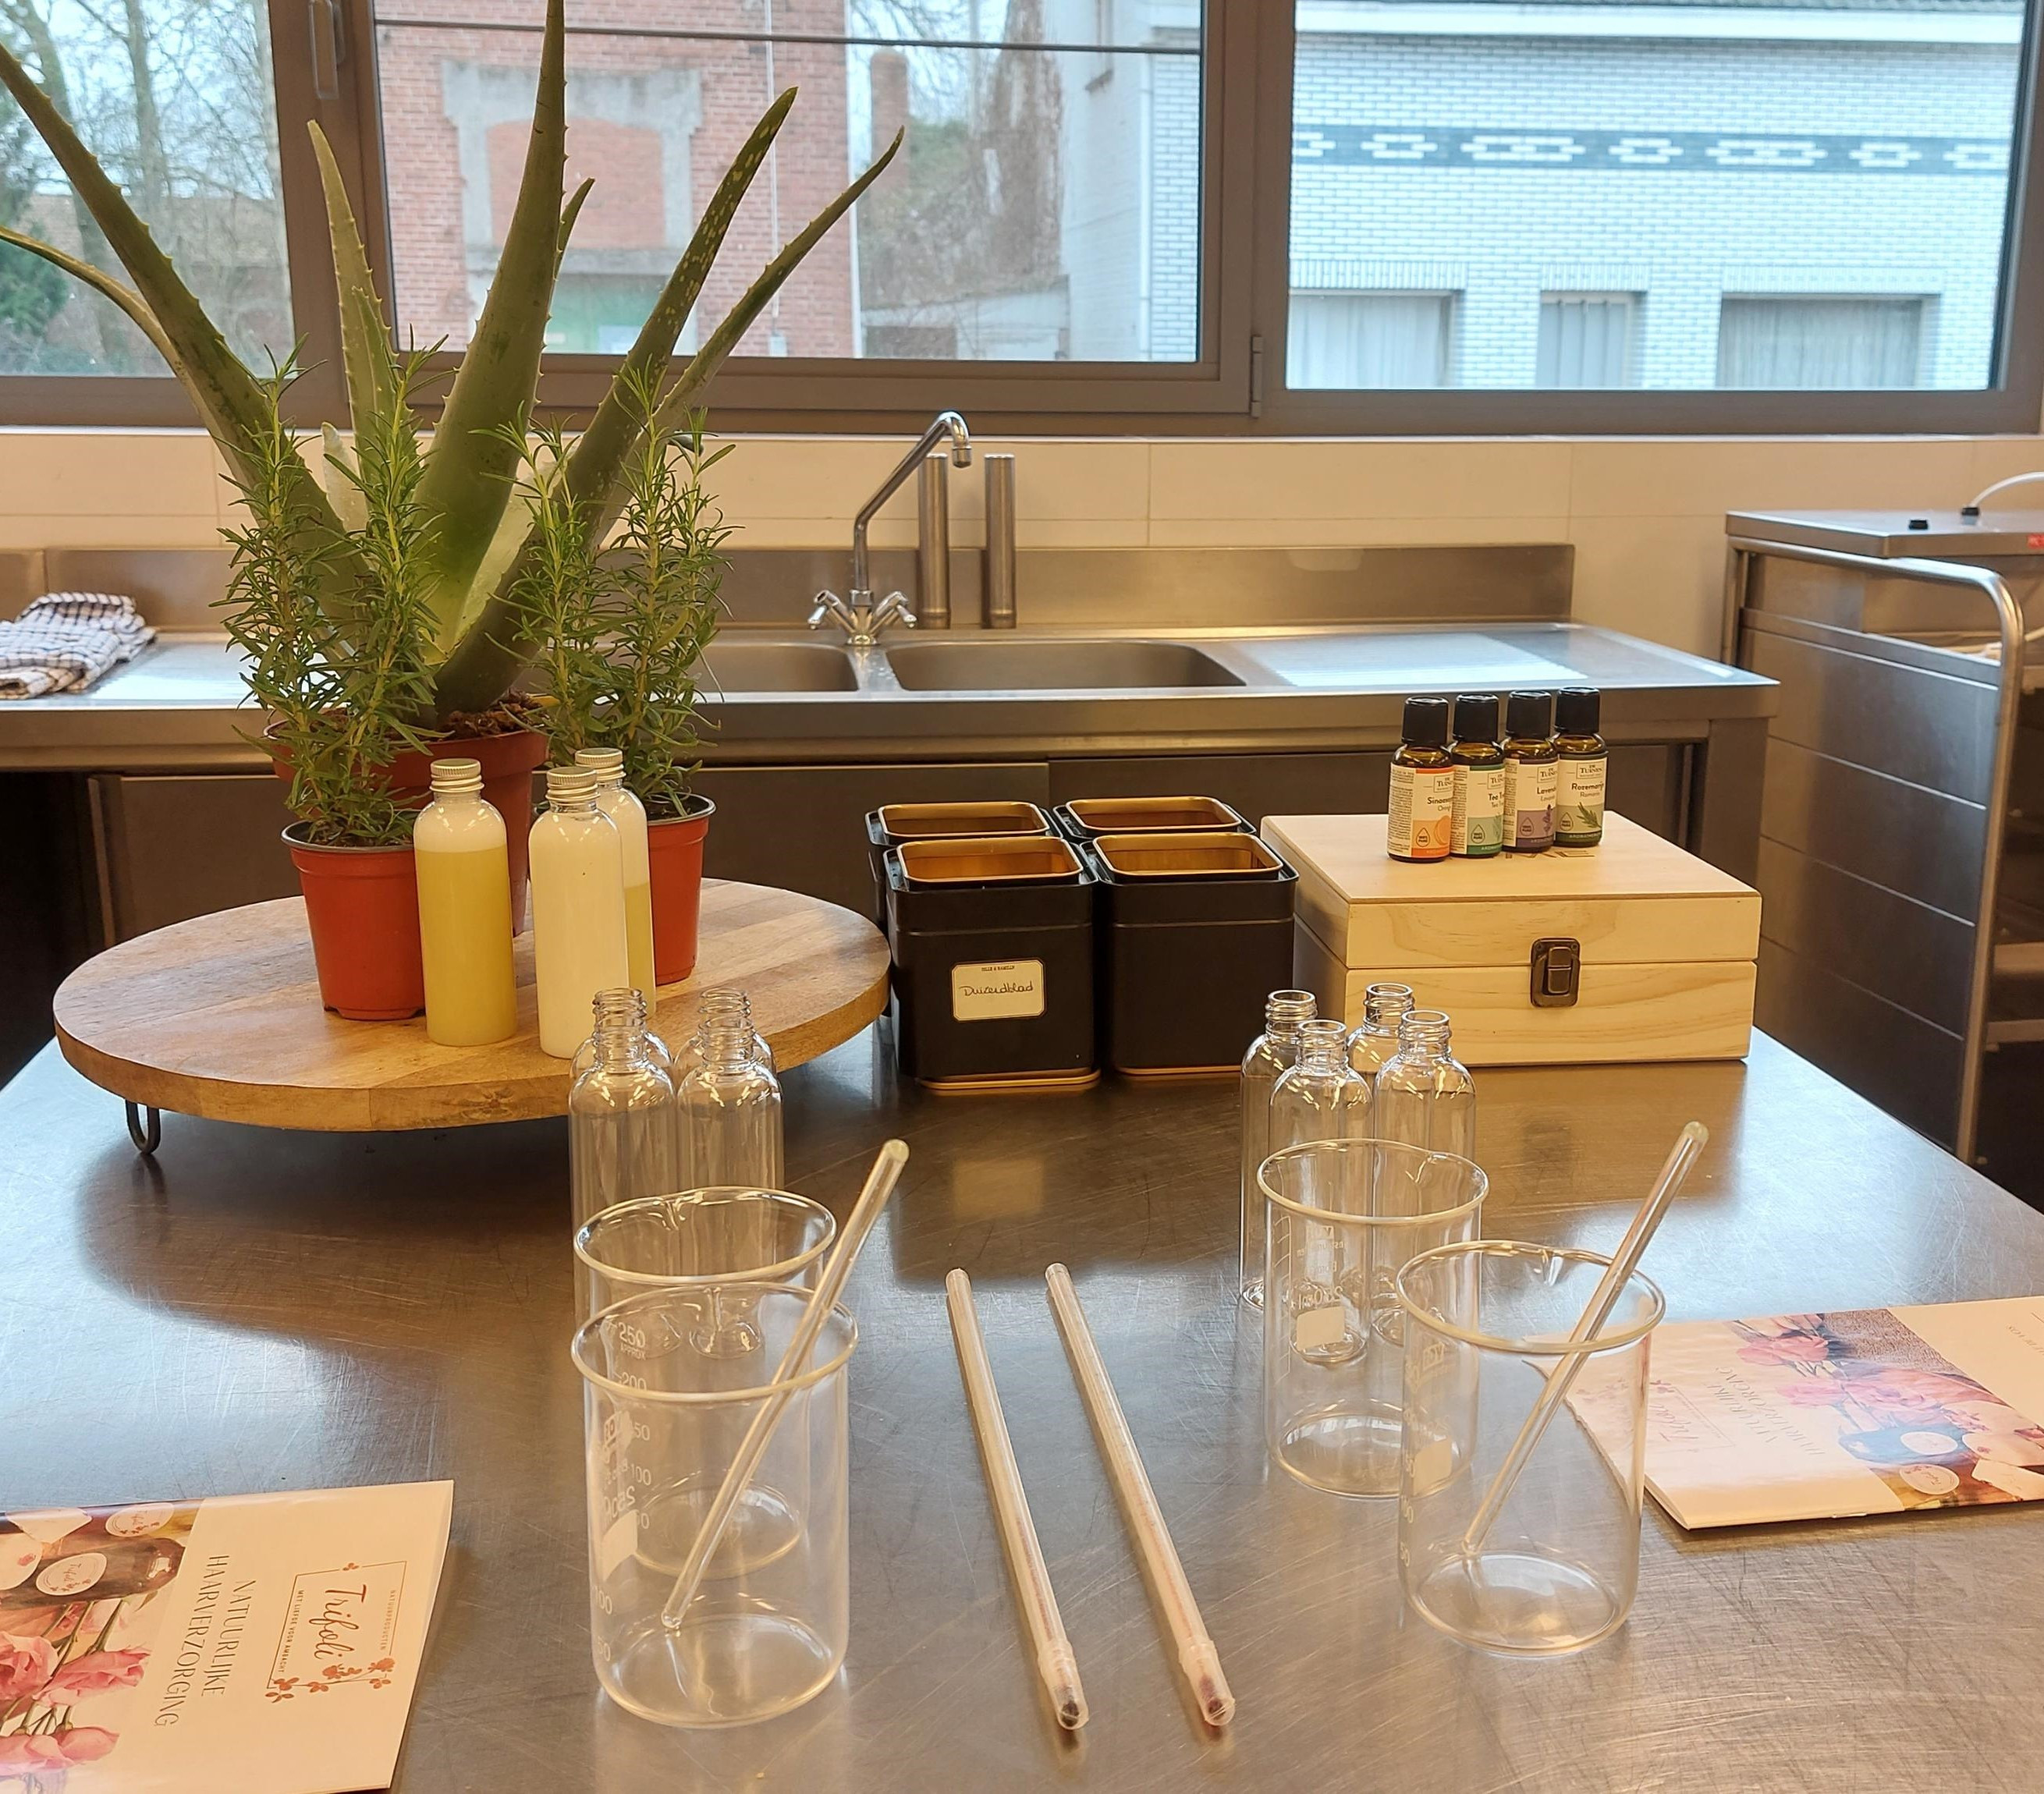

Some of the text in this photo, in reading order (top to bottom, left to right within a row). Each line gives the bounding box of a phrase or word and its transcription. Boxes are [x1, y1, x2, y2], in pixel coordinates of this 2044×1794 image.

[618, 1322, 646, 1349] 250
[633, 1425, 651, 1441] 50
[631, 1463, 651, 1486] 100
[292, 1604, 301, 1624] LIEFDE
[308, 1584, 367, 1660] Trifoli
[154, 1555, 230, 1727] HAARVERZORGING
[201, 1580, 257, 1697] NATUURLIJKE
[286, 1626, 296, 1643] VOOR
[278, 1644, 292, 1673] AMBACHT
